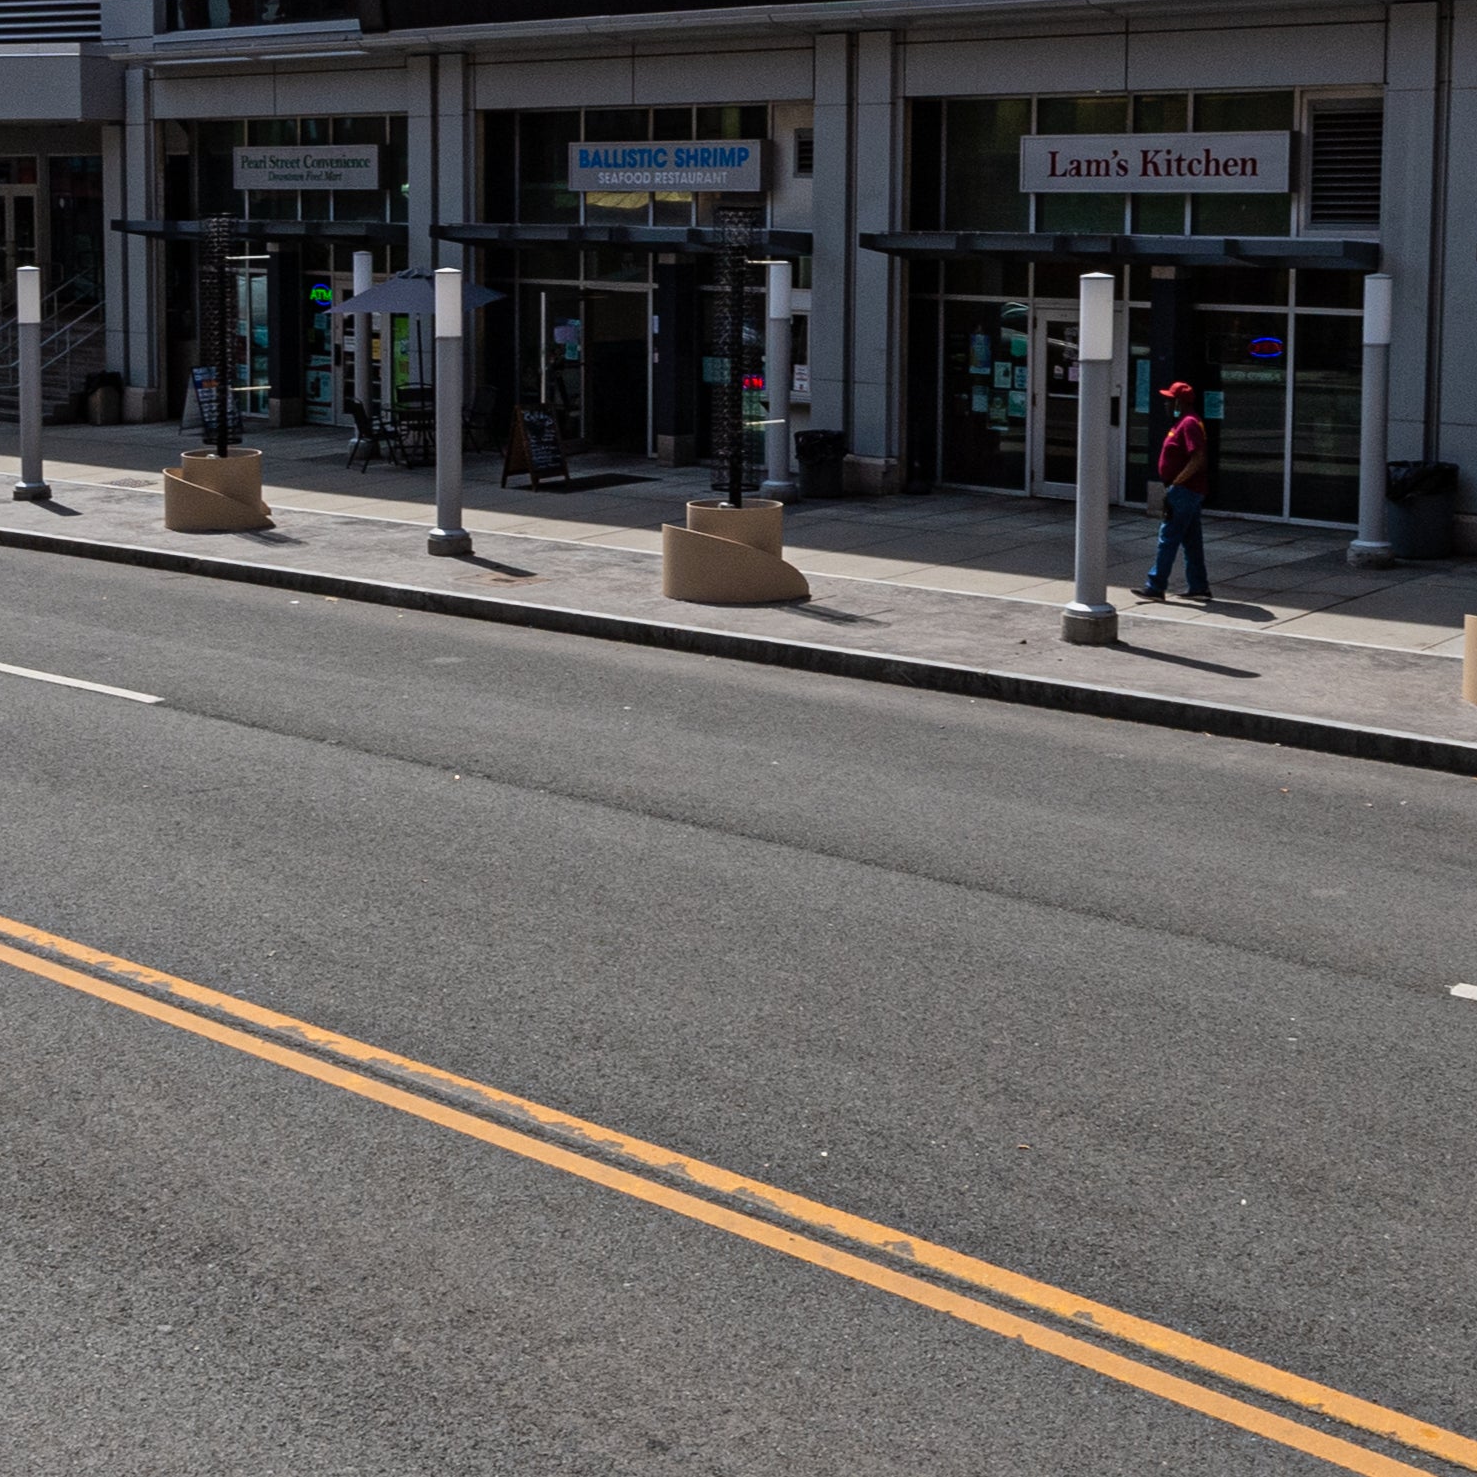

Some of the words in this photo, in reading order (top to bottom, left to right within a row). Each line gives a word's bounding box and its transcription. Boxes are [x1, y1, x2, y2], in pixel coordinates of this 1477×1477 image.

[240, 155, 268, 170] Pearl
[269, 154, 301, 169] Street
[303, 154, 371, 169] Convenience
[578, 147, 669, 169] BALLISTIC
[674, 146, 751, 168] SHRIMP
[1047, 150, 1129, 178] Lam's
[1139, 148, 1259, 178] Kitchen
[597, 171, 651, 185] SEAFOOD
[654, 170, 728, 185] RESTAURANT
[310, 289, 333, 301] ATM
